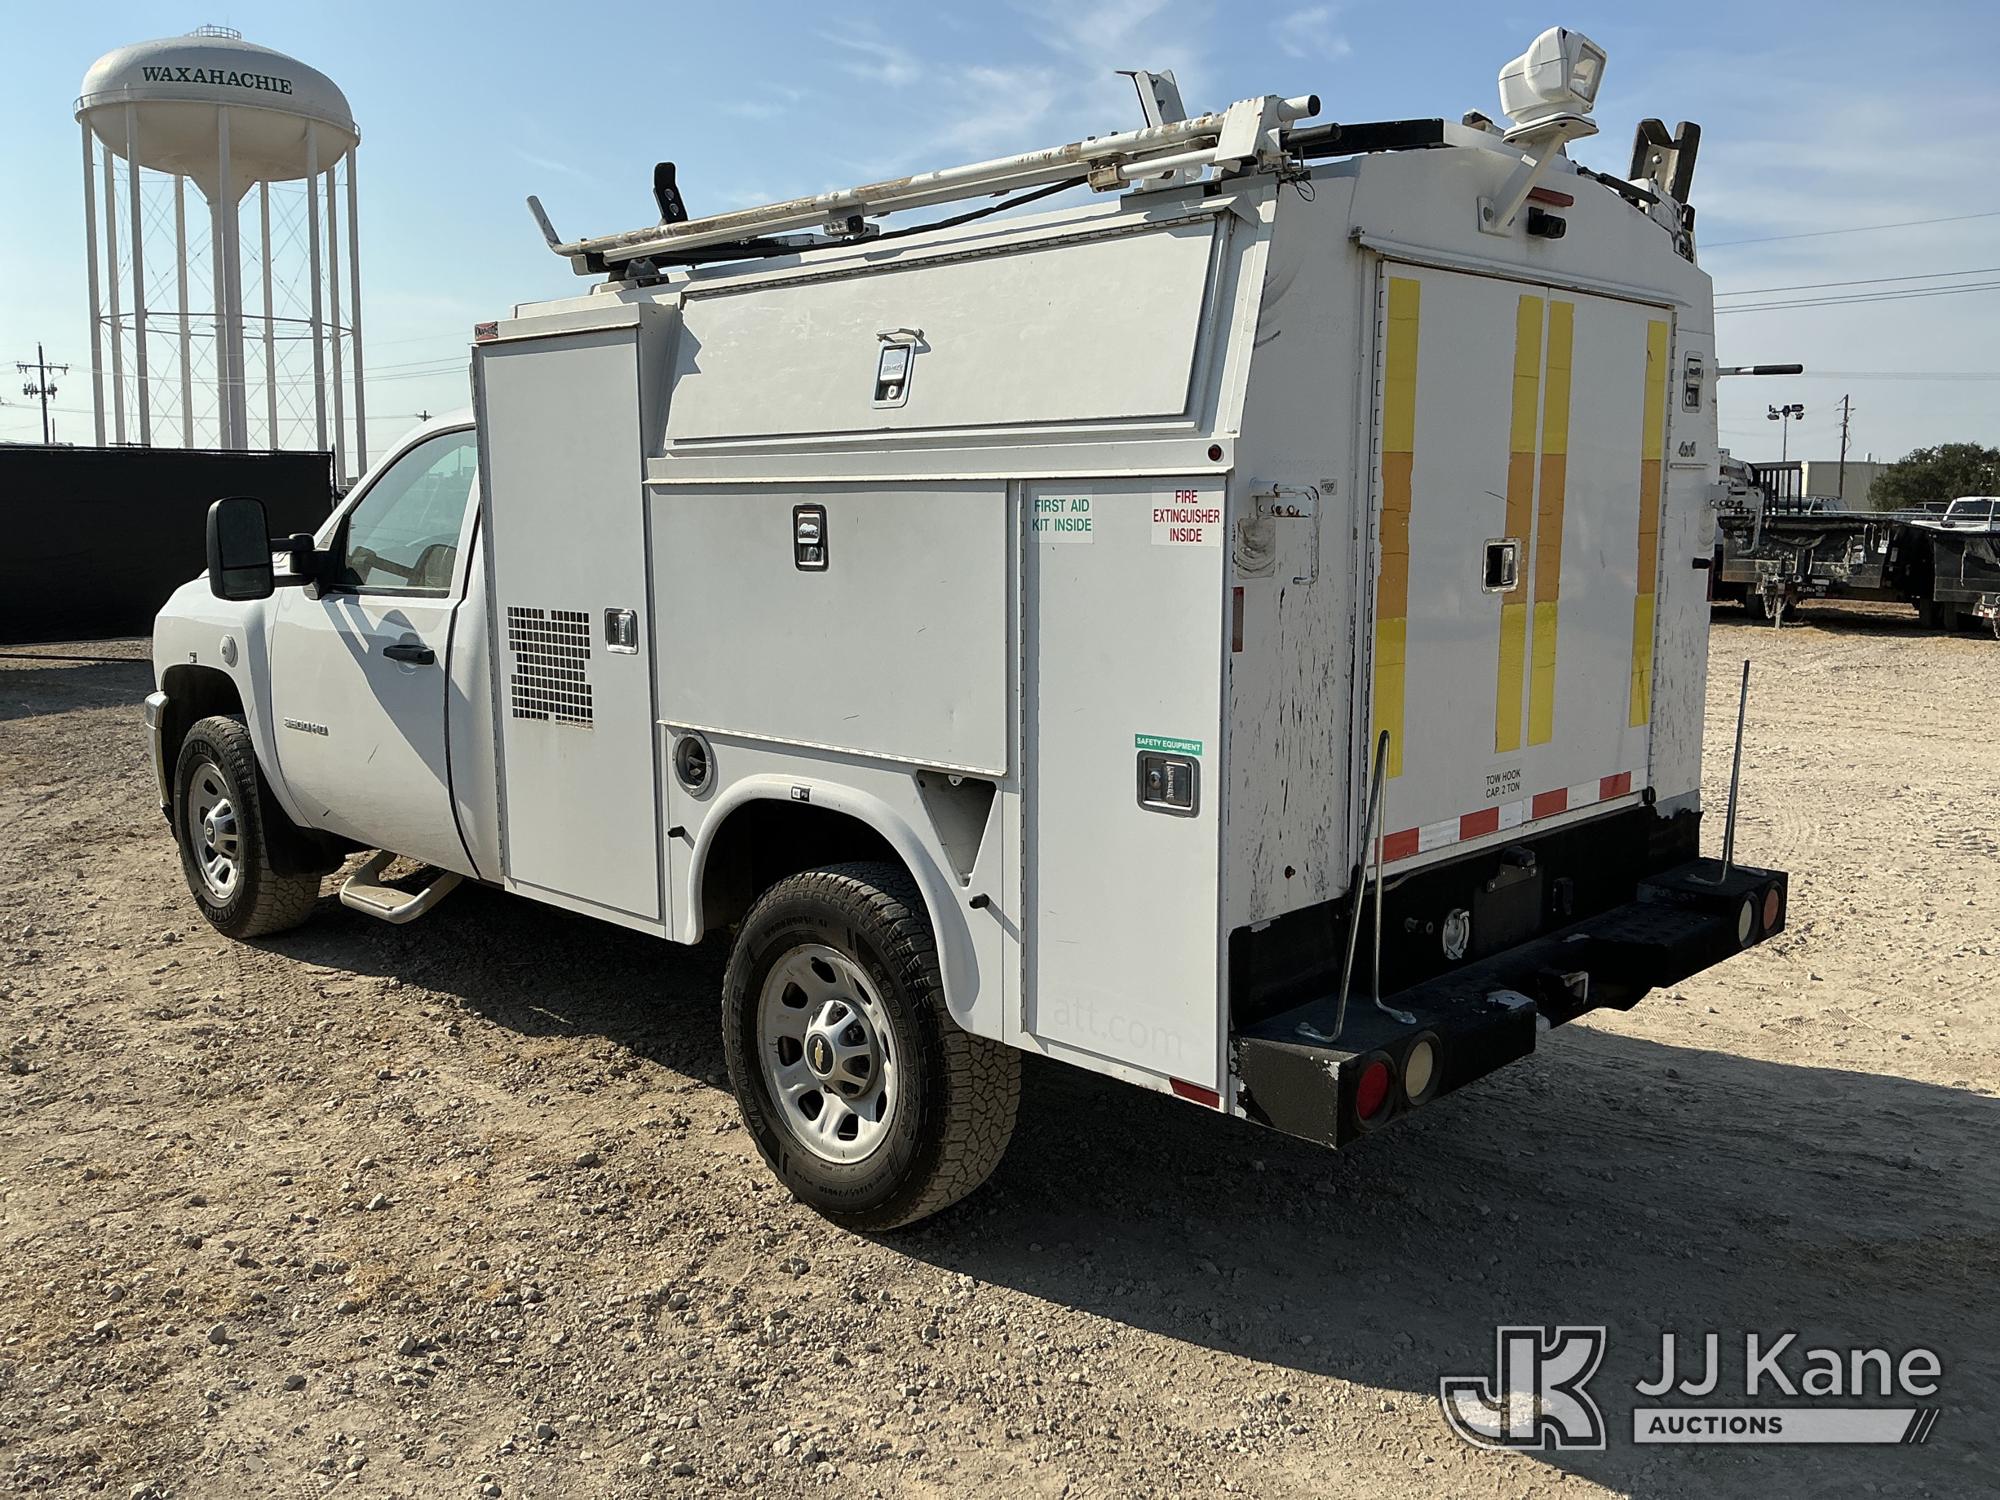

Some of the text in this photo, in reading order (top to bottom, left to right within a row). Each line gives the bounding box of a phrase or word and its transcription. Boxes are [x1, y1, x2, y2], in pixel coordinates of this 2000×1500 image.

[142, 66, 293, 95] WAXAHACHIE
[1175, 489, 1198, 504] FIRE
[1034, 498, 1090, 513] FIRST AID
[1153, 508, 1220, 524] EXTINGUISHER
[1032, 518, 1092, 532] KIT INSIDE
[1169, 527, 1202, 543] INSIDE
[1136, 737, 1201, 751] SAFETY EQUIPMENT
[1486, 768, 1521, 786] TOW HOOK
[1507, 781, 1520, 793] TON
[1053, 996, 1182, 1058] att.com
